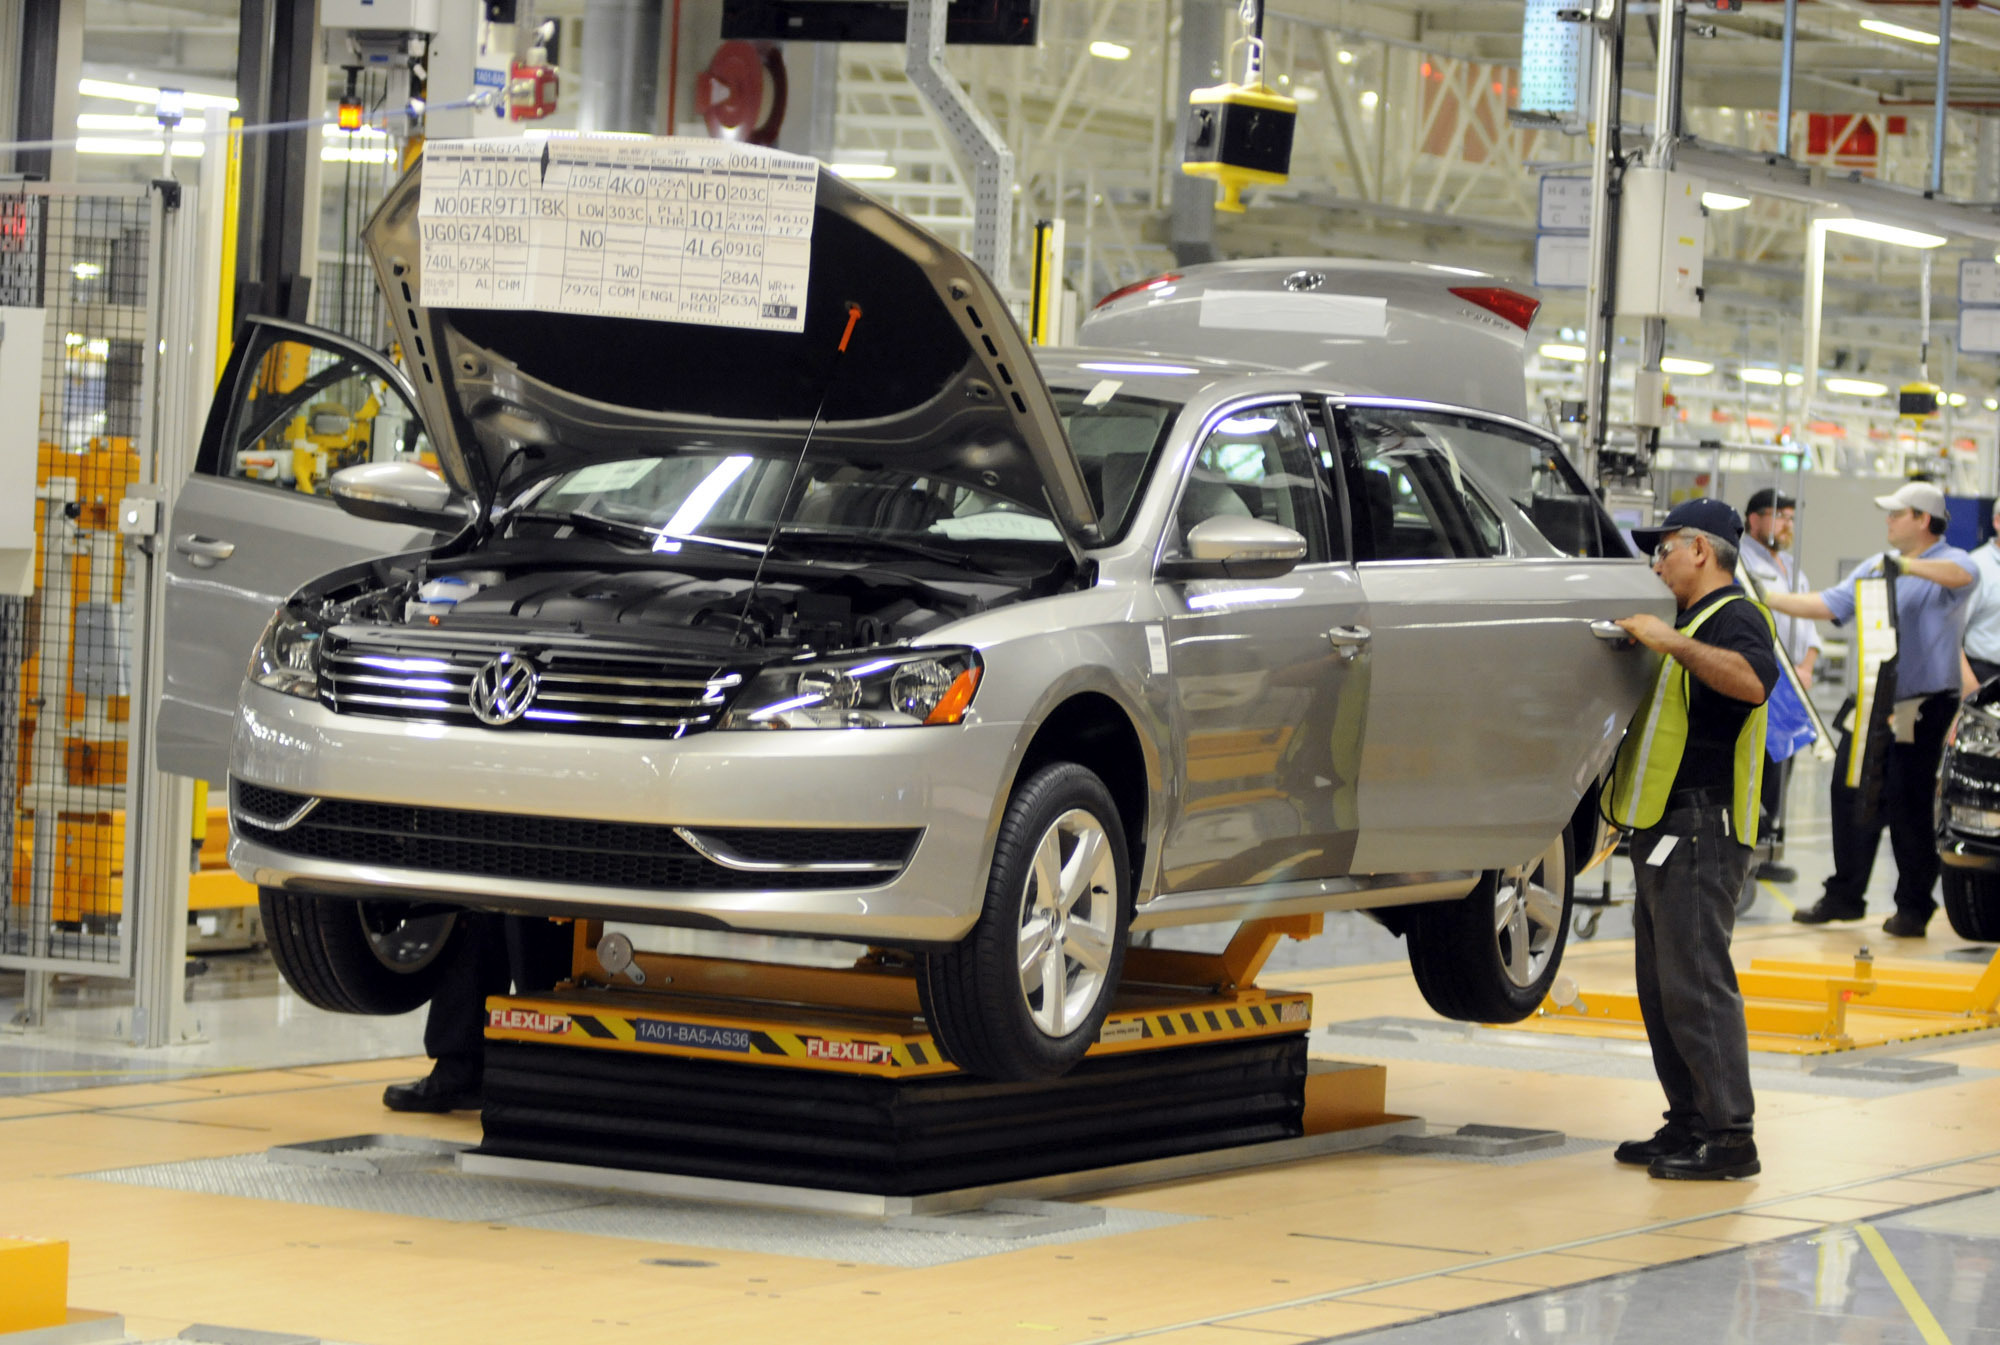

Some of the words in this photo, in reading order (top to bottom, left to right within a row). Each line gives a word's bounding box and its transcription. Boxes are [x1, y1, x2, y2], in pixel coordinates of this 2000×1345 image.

[731, 154, 767, 170] 0041
[571, 175, 606, 190] 105E
[730, 186, 766, 203] 203C
[533, 198, 566, 217] T8K
[577, 203, 605, 218] LOW
[608, 206, 644, 222] 303C
[690, 209, 724, 232] 1Q1
[459, 224, 493, 242] G74
[495, 225, 528, 244] DBL
[579, 229, 603, 249] NO
[685, 237, 723, 258] 4L6
[425, 253, 457, 271] 740L
[460, 256, 492, 271] 675K
[614, 264, 640, 279] TWO
[722, 270, 760, 287] 284A
[497, 279, 521, 291] CHM
[564, 283, 599, 297] 797G
[608, 286, 635, 298] COM
[642, 289, 677, 304] ENGL
[690, 292, 718, 304] RAD
[721, 294, 758, 308] 263A
[491, 1008, 572, 1032] FLEXLIFT
[640, 1023, 749, 1047] 1A01-BA5-AS36
[807, 1039, 891, 1063] FLEXLIFT
